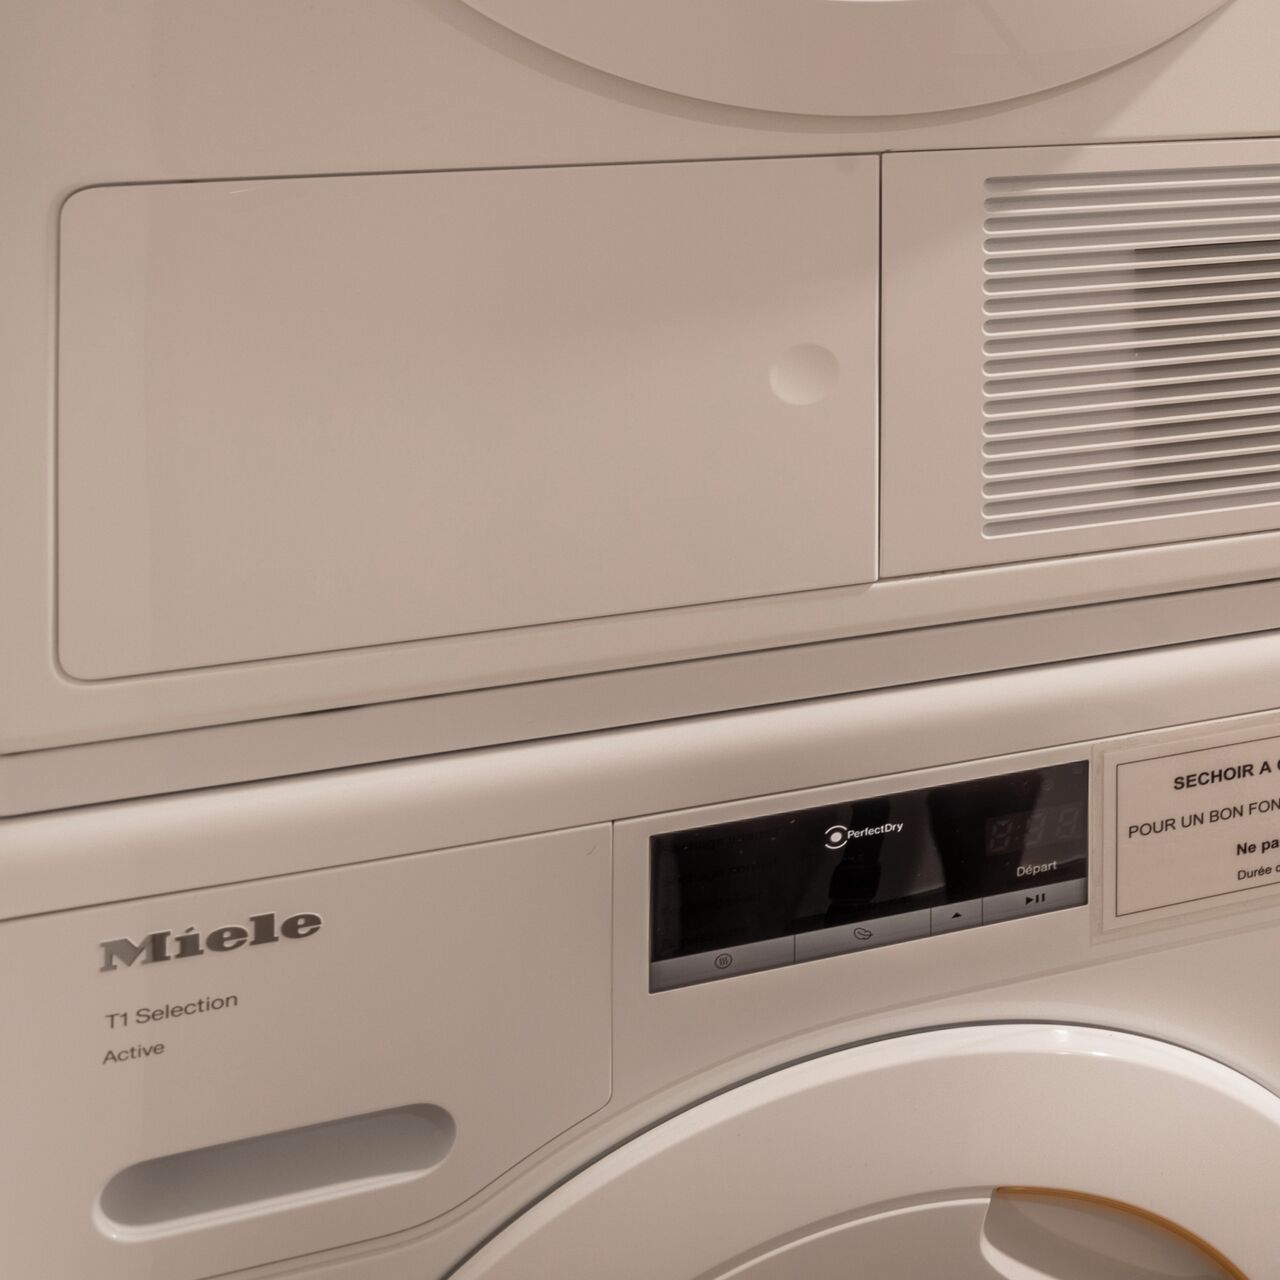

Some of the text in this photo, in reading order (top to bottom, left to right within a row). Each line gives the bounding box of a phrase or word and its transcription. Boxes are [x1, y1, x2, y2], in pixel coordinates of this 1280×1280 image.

[1173, 763, 1254, 791] SECHOIR
[1259, 760, 1272, 775] A
[847, 822, 904, 840] PerfectDry
[1128, 817, 1177, 839] POUR
[1181, 812, 1204, 829] UN
[1209, 804, 1244, 823] BON
[1236, 840, 1257, 857] Ne
[1016, 860, 1057, 878] Départ
[1237, 864, 1273, 881] Durée
[99, 912, 322, 973] Miele
[105, 993, 239, 1029] T1 Selection
[102, 1041, 165, 1065] Active
